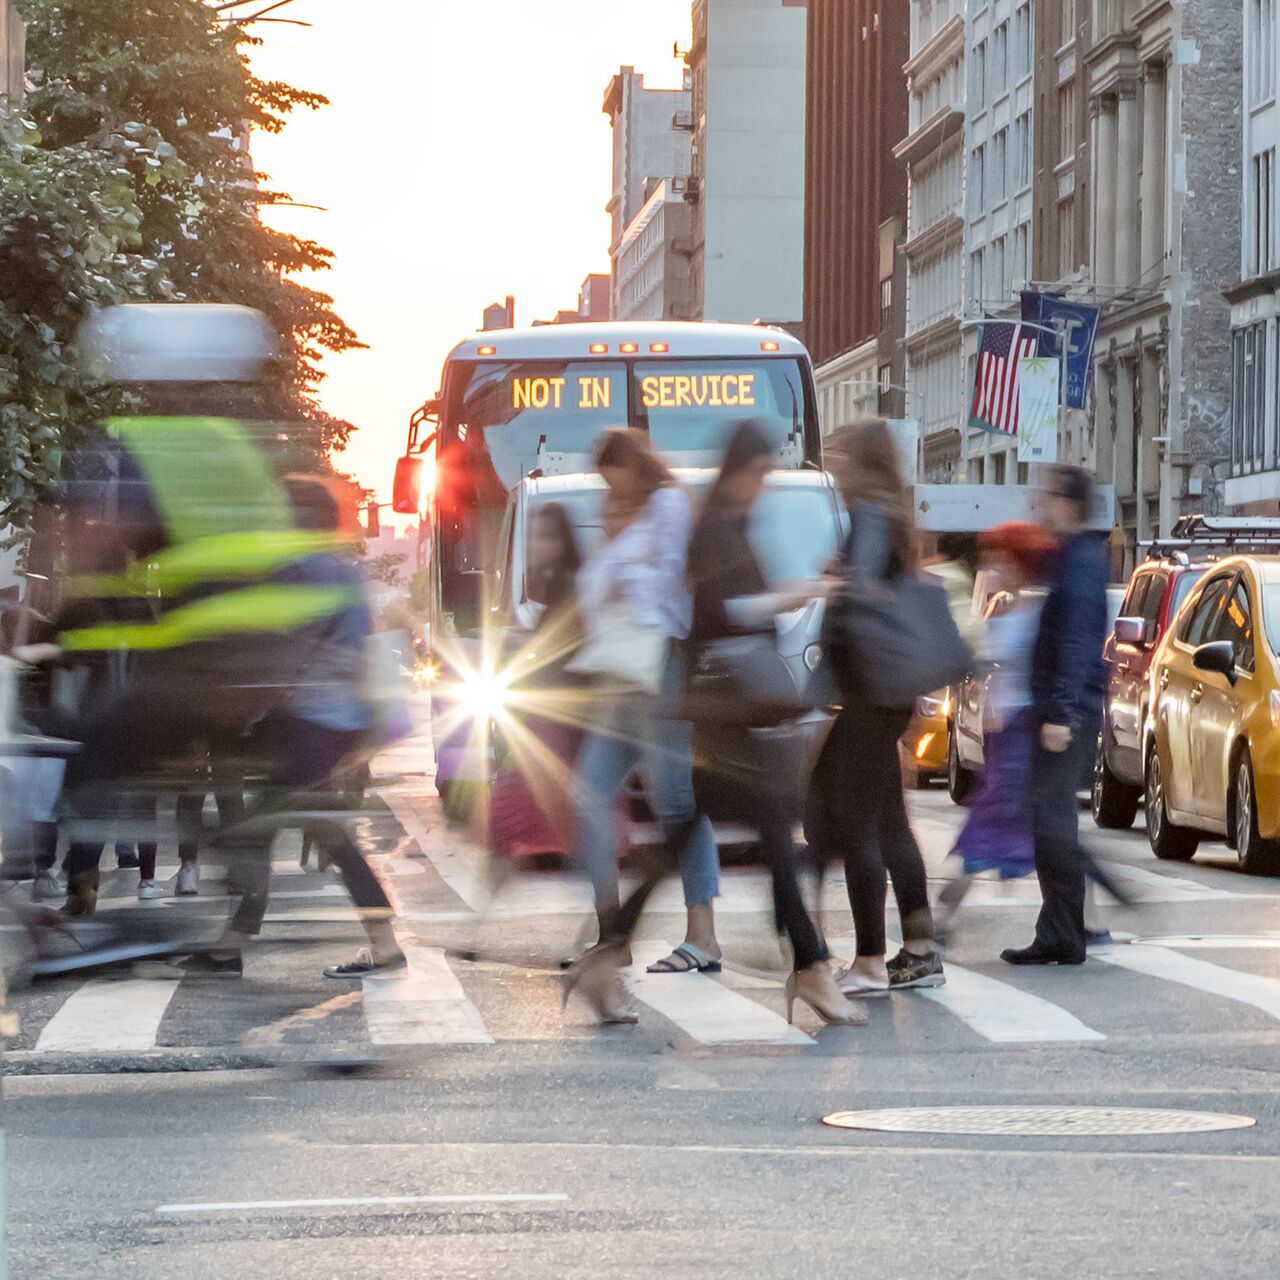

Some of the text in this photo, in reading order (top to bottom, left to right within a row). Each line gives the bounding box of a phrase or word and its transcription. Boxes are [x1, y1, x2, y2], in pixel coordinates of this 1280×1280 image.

[512, 374, 755, 409] NOT IN SERVICE
